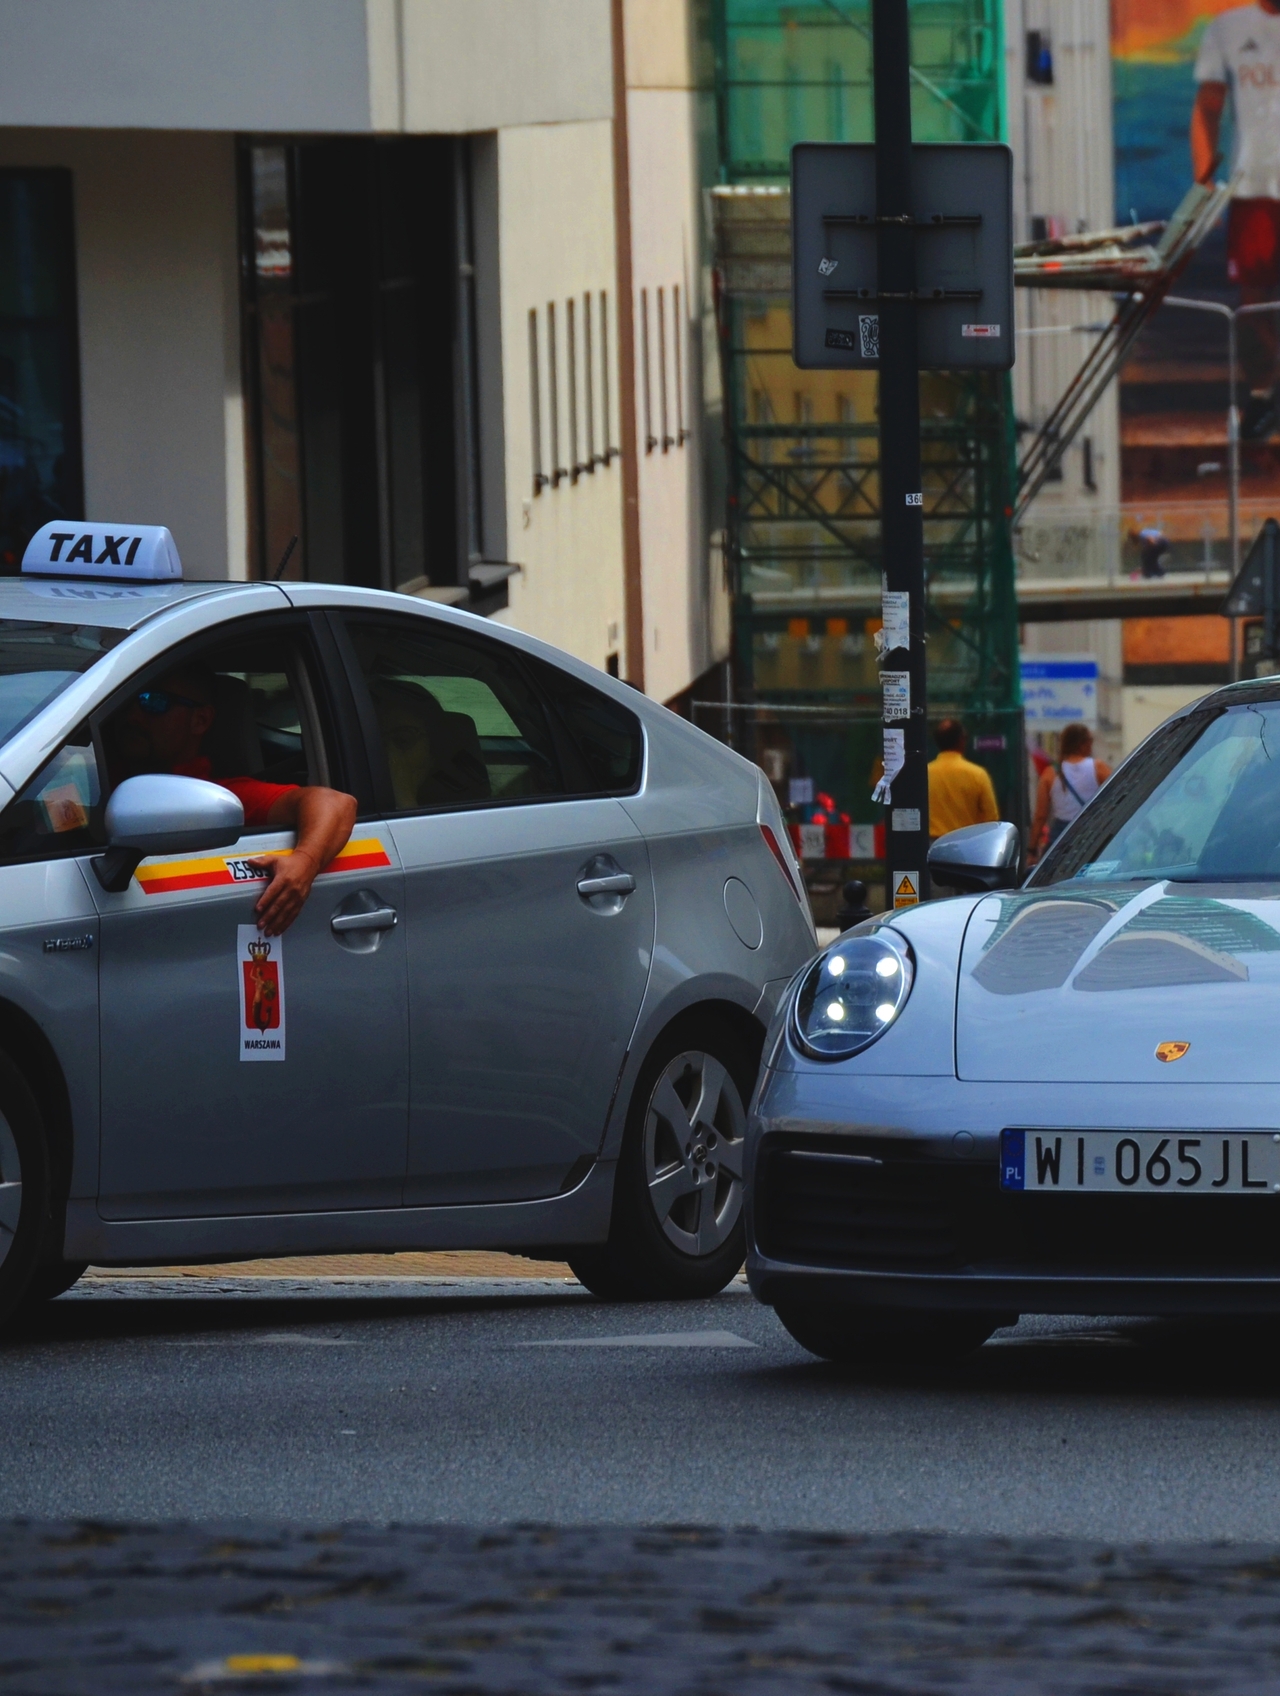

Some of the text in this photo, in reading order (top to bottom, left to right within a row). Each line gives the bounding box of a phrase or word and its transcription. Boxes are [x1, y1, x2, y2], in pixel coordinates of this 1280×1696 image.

[49, 533, 142, 566] TAXI
[893, 707, 908, 715] 018
[244, 1040, 281, 1049] WARSZAWA
[1035, 1136, 1268, 1188] WI 065JL
[1006, 1167, 1021, 1180] PL
